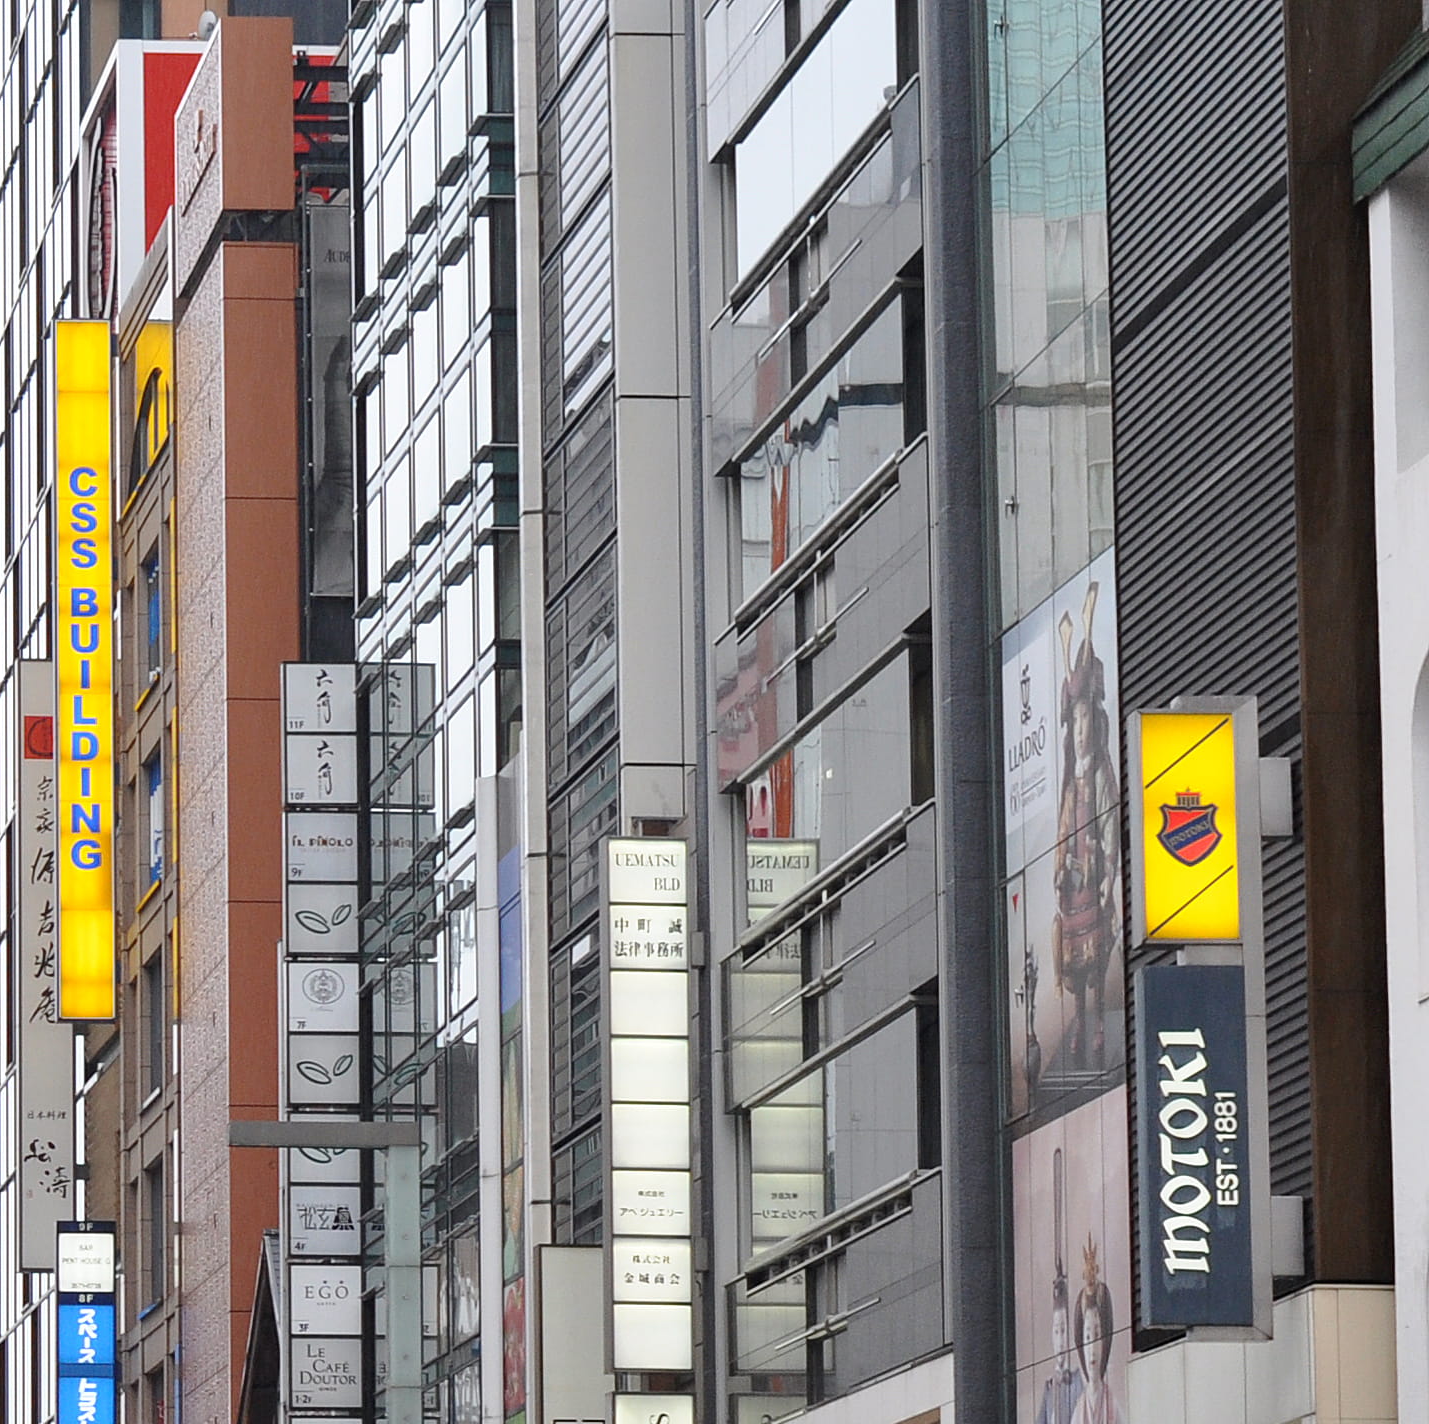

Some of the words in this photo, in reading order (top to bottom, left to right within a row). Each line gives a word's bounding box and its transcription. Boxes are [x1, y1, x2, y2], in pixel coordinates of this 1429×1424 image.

[68, 467, 98, 569] CSS
[69, 587, 102, 871] BUILDING
[615, 854, 679, 867] UEMATSU
[654, 878, 680, 891] BLD
[77, 1308, 97, 1363] スペース
[299, 1371, 357, 1385] DOUTOR
